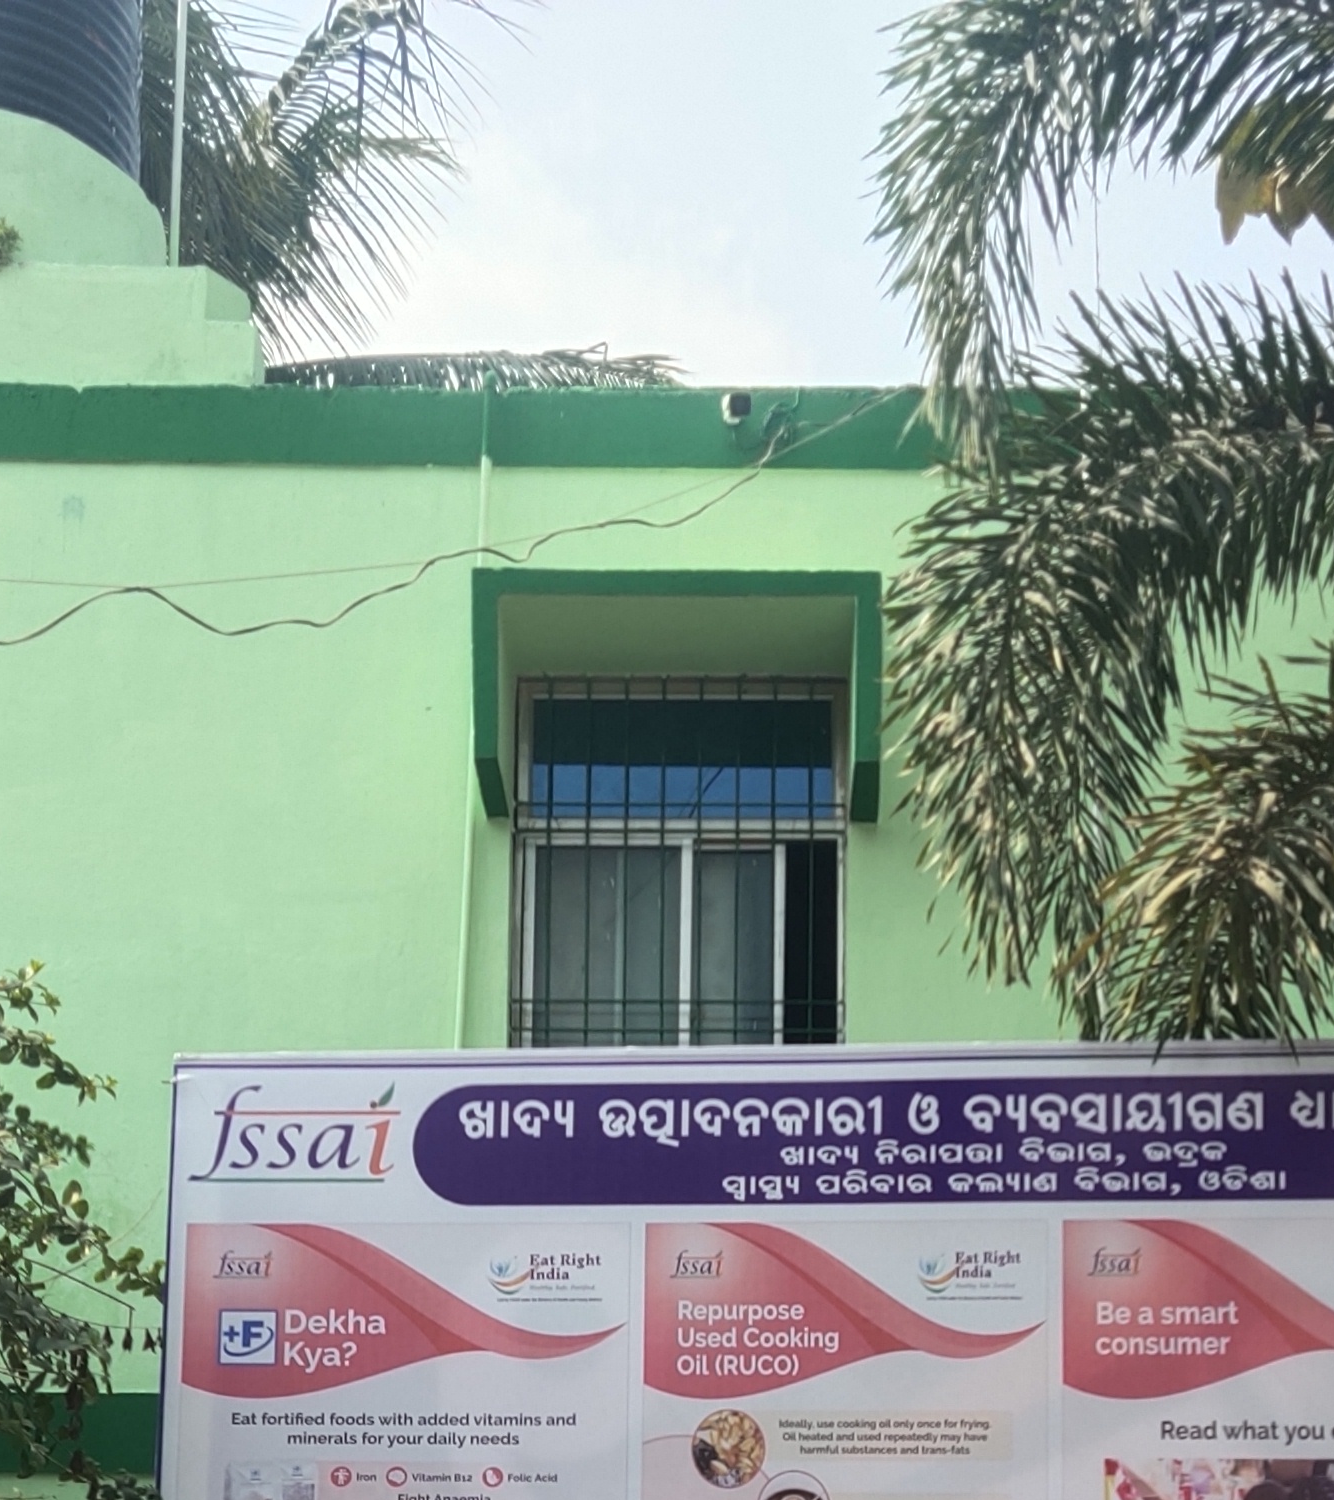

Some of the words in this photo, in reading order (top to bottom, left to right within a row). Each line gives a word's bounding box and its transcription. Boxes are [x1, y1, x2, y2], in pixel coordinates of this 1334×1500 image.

[458, 1100, 575, 1138] ଖାଦ୍ୟ
[908, 1092, 940, 1134] ଓ
[188, 1081, 401, 1182] fssai
[780, 1145, 858, 1165] ଖାଦ୍ୟ
[1143, 1141, 1227, 1167] ଭଦ୍ରକ
[816, 1168, 932, 1194] ପରିବାର
[530, 1268, 569, 1281] India
[284, 1309, 386, 1336] Dekha
[677, 1301, 804, 1325] Repurpose
[1096, 1301, 1129, 1325] Be
[1138, 1307, 1154, 1325] a
[1161, 1301, 1239, 1325] smart
[677, 1327, 736, 1348] Used
[743, 1327, 840, 1353] Cooking
[1095, 1335, 1231, 1355] consumer
[283, 1342, 357, 1374] Kya?
[677, 1355, 709, 1375] Oil
[715, 1355, 799, 1377] (RUCO)
[231, 1412, 257, 1427] Eat
[261, 1412, 325, 1427] fortified
[330, 1412, 375, 1427] foods
[379, 1412, 413, 1427] with
[418, 1412, 469, 1427] added
[473, 1412, 542, 1427] vitamins
[546, 1412, 576, 1427] and
[287, 1432, 357, 1446] minerals
[362, 1432, 384, 1446] for
[387, 1435, 422, 1448] your
[427, 1432, 466, 1449] daily
[470, 1432, 519, 1446] needs
[1161, 1421, 1217, 1440] Read
[1223, 1420, 1279, 1440] what
[1285, 1424, 1325, 1446] you
[356, 1473, 376, 1483] Iron
